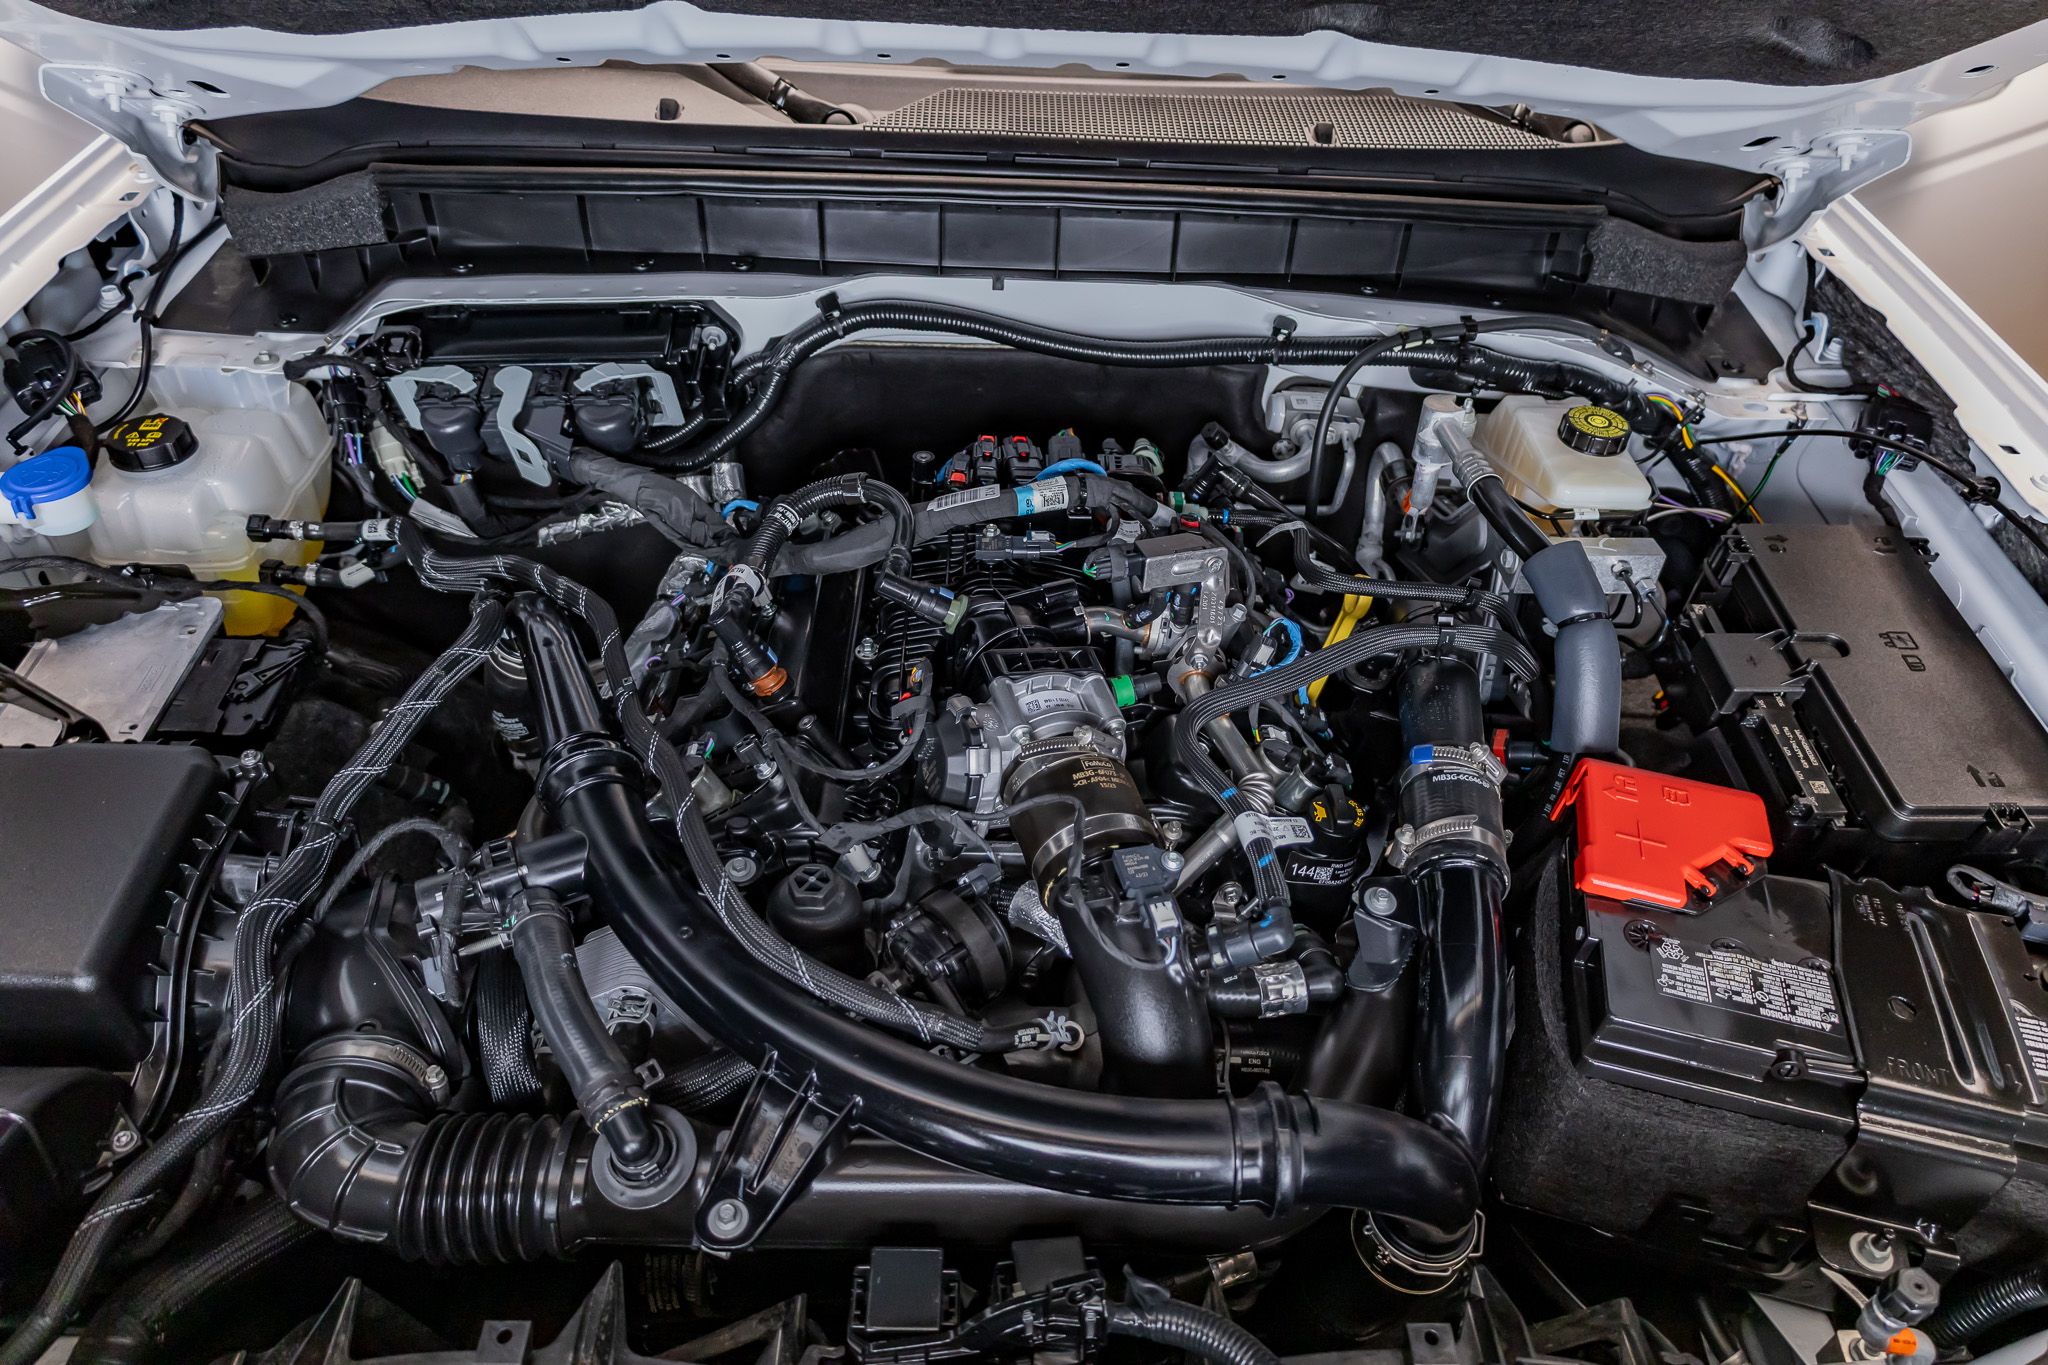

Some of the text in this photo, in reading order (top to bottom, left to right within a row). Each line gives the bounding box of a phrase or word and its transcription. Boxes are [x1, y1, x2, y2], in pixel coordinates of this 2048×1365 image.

[1291, 863, 1315, 878] 144
[1759, 1007, 1822, 1028] DANGER/POISON
[1887, 1056, 1949, 1086] FRONT
